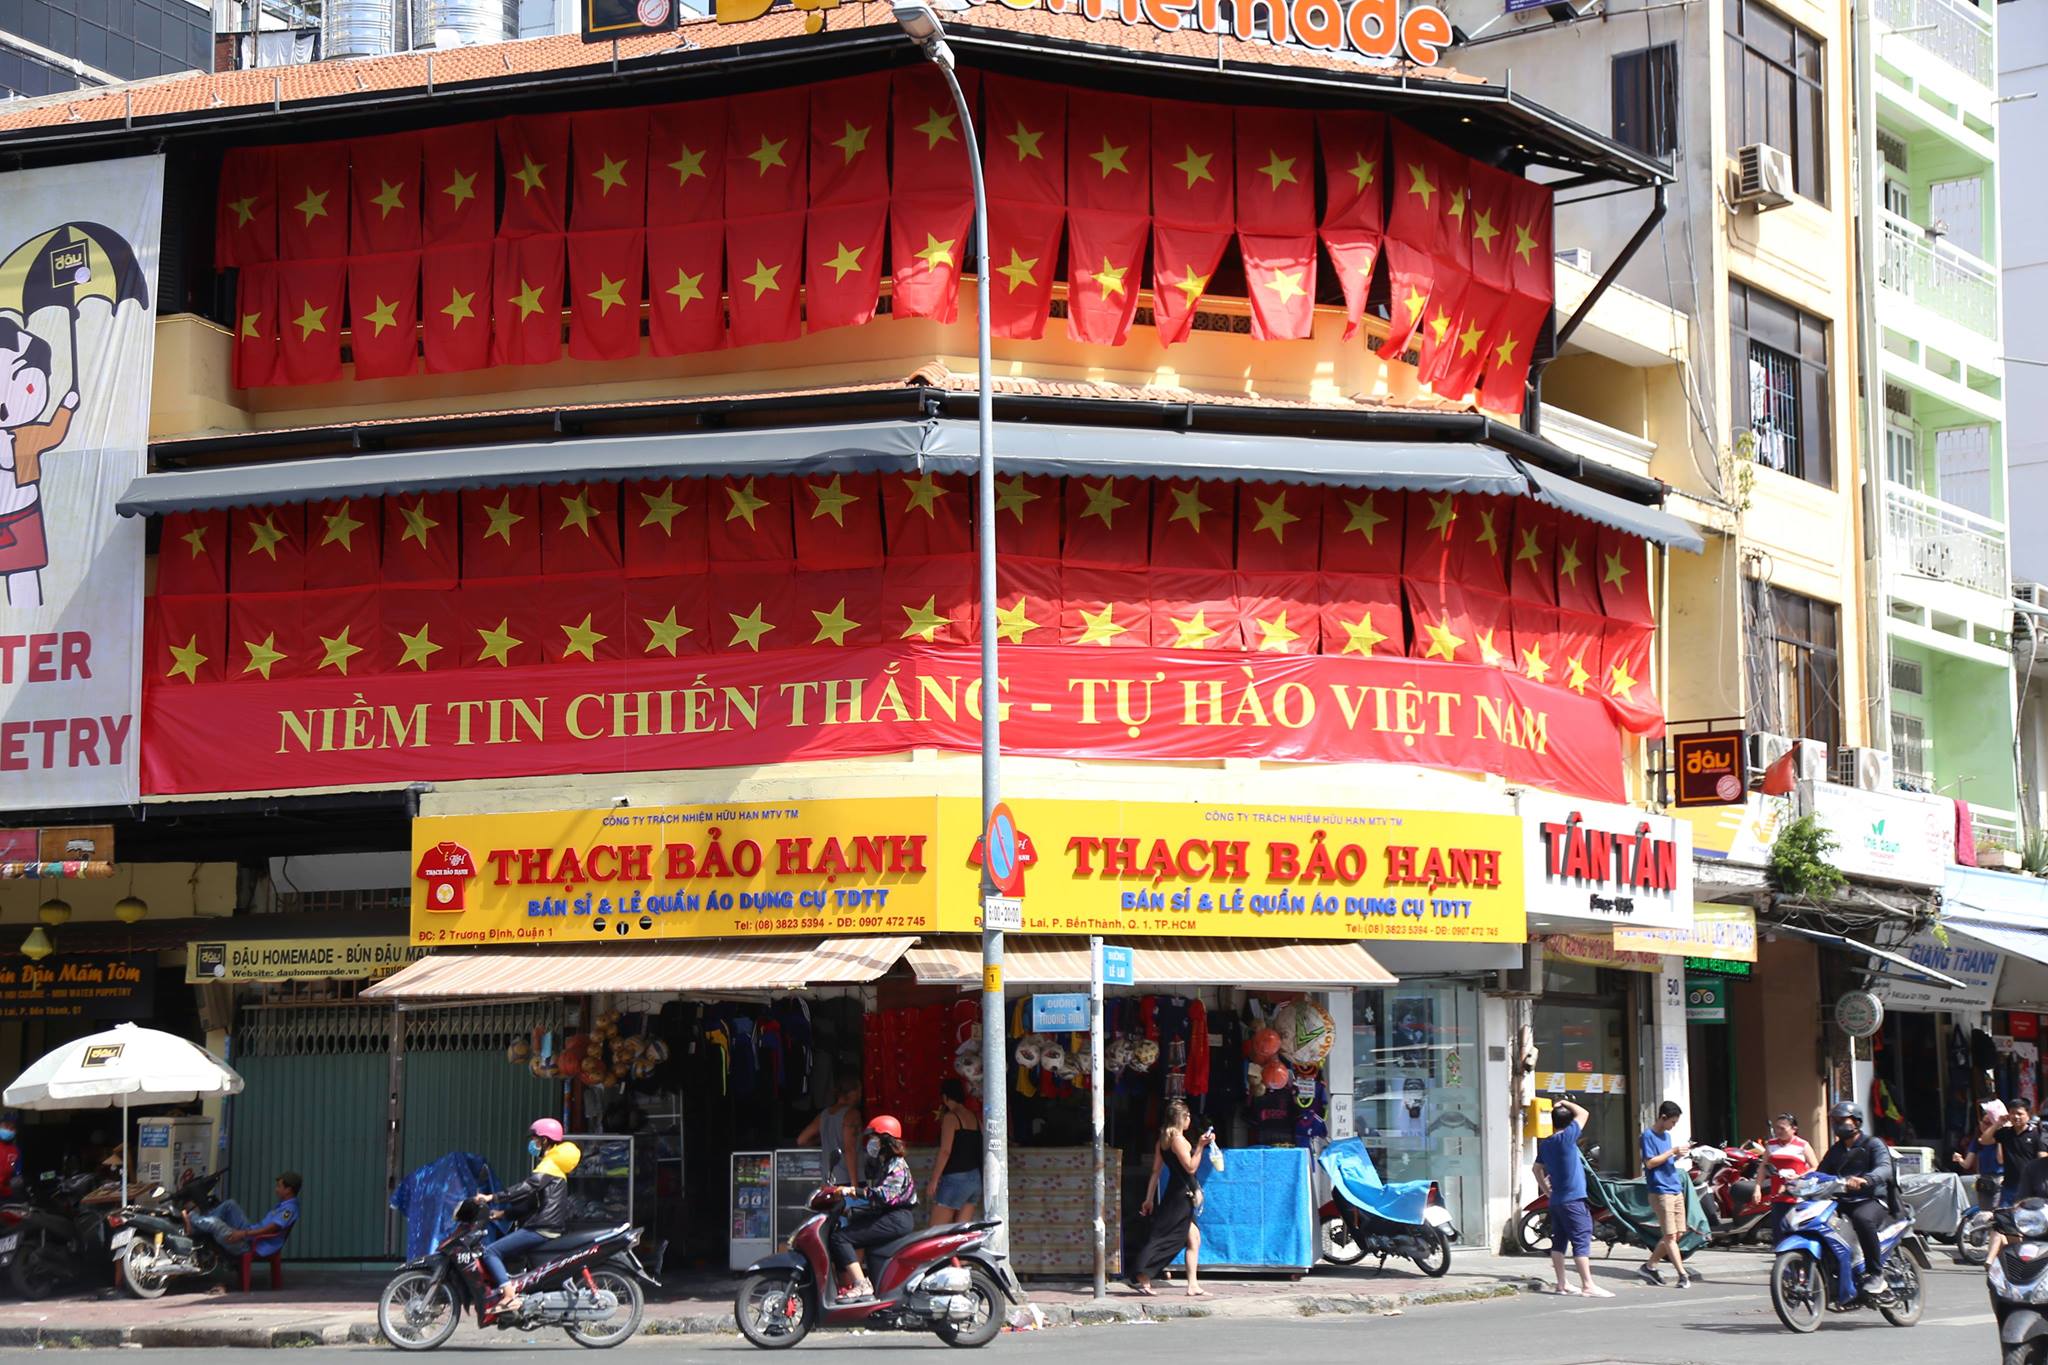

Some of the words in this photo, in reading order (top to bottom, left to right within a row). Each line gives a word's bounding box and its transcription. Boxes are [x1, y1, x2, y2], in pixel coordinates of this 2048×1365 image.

[276, 692, 430, 755] NIỀM
[447, 696, 546, 746] TIN
[564, 674, 760, 741] CHIẾN
[780, 661, 1011, 728] THẮNG
[1068, 671, 1166, 739] TỰ
[1179, 667, 1316, 729] HÀO
[1327, 680, 1462, 747] VIỆT
[1474, 695, 1549, 756] NAM
[602, 814, 629, 826] CÔNG
[633, 816, 645, 824] TY
[647, 813, 679, 824] TRÁCH
[682, 811, 713, 823] NHIỆM
[762, 810, 782, 819] MTV
[784, 809, 799, 818] TM
[1204, 811, 1234, 821] CÔNG
[1237, 812, 1249, 821] TY
[1540, 810, 1610, 884] TÂN
[1612, 821, 1676, 891] TÂN
[487, 844, 652, 892] THẠCH
[665, 827, 763, 879] BẢO
[776, 835, 928, 883] HẠNH
[1067, 836, 1250, 887] THẠCH
[1268, 829, 1368, 882] BẢO
[1384, 843, 1502, 893] HẠNH
[528, 896, 567, 917] BÁN
[598, 898, 612, 914] &
[619, 890, 642, 914] LẺ
[646, 889, 700, 915] QUẦN
[706, 890, 734, 910] ÁO
[740, 891, 793, 913] DỤNG
[799, 890, 827, 911] CỤ
[833, 889, 889, 908] TDTT
[1121, 888, 1165, 911] BÁN
[1198, 893, 1214, 911] &
[1312, 892, 1339, 913] ÁO
[1345, 896, 1397, 920] DỤNG
[1402, 898, 1425, 921] CỤ
[1431, 899, 1472, 918] TDTT
[734, 920, 752, 930] Tel:
[755, 919, 773, 931] (08)
[776, 918, 799, 929] 3823
[801, 918, 825, 928] 5394
[859, 917, 883, 927] 0907
[886, 916, 905, 926] 472
[907, 916, 926, 926] 745
[1052, 918, 1062, 928] P.
[1128, 919, 1139, 929] Q.
[1365, 924, 1383, 934] (08)
[1452, 927, 1470, 936] 0907
[1471, 927, 1484, 936] 472
[1487, 927, 1499, 936] 745
[419, 931, 435, 941] ĐC:
[439, 930, 446, 939] 2
[450, 930, 485, 941] Trương
[517, 927, 545, 939] Quận
[232, 947, 259, 968] ĐẬU
[263, 948, 333, 966] HOMEMADE
[346, 943, 371, 963] BÚN
[375, 943, 401, 965] ĐẬU
[107, 962, 141, 983] Tôm
[232, 969, 274, 977] Website:
[277, 968, 360, 977] dauhomemade.vn
[990, 974, 995, 982] 1
[1667, 979, 1679, 995] 50
